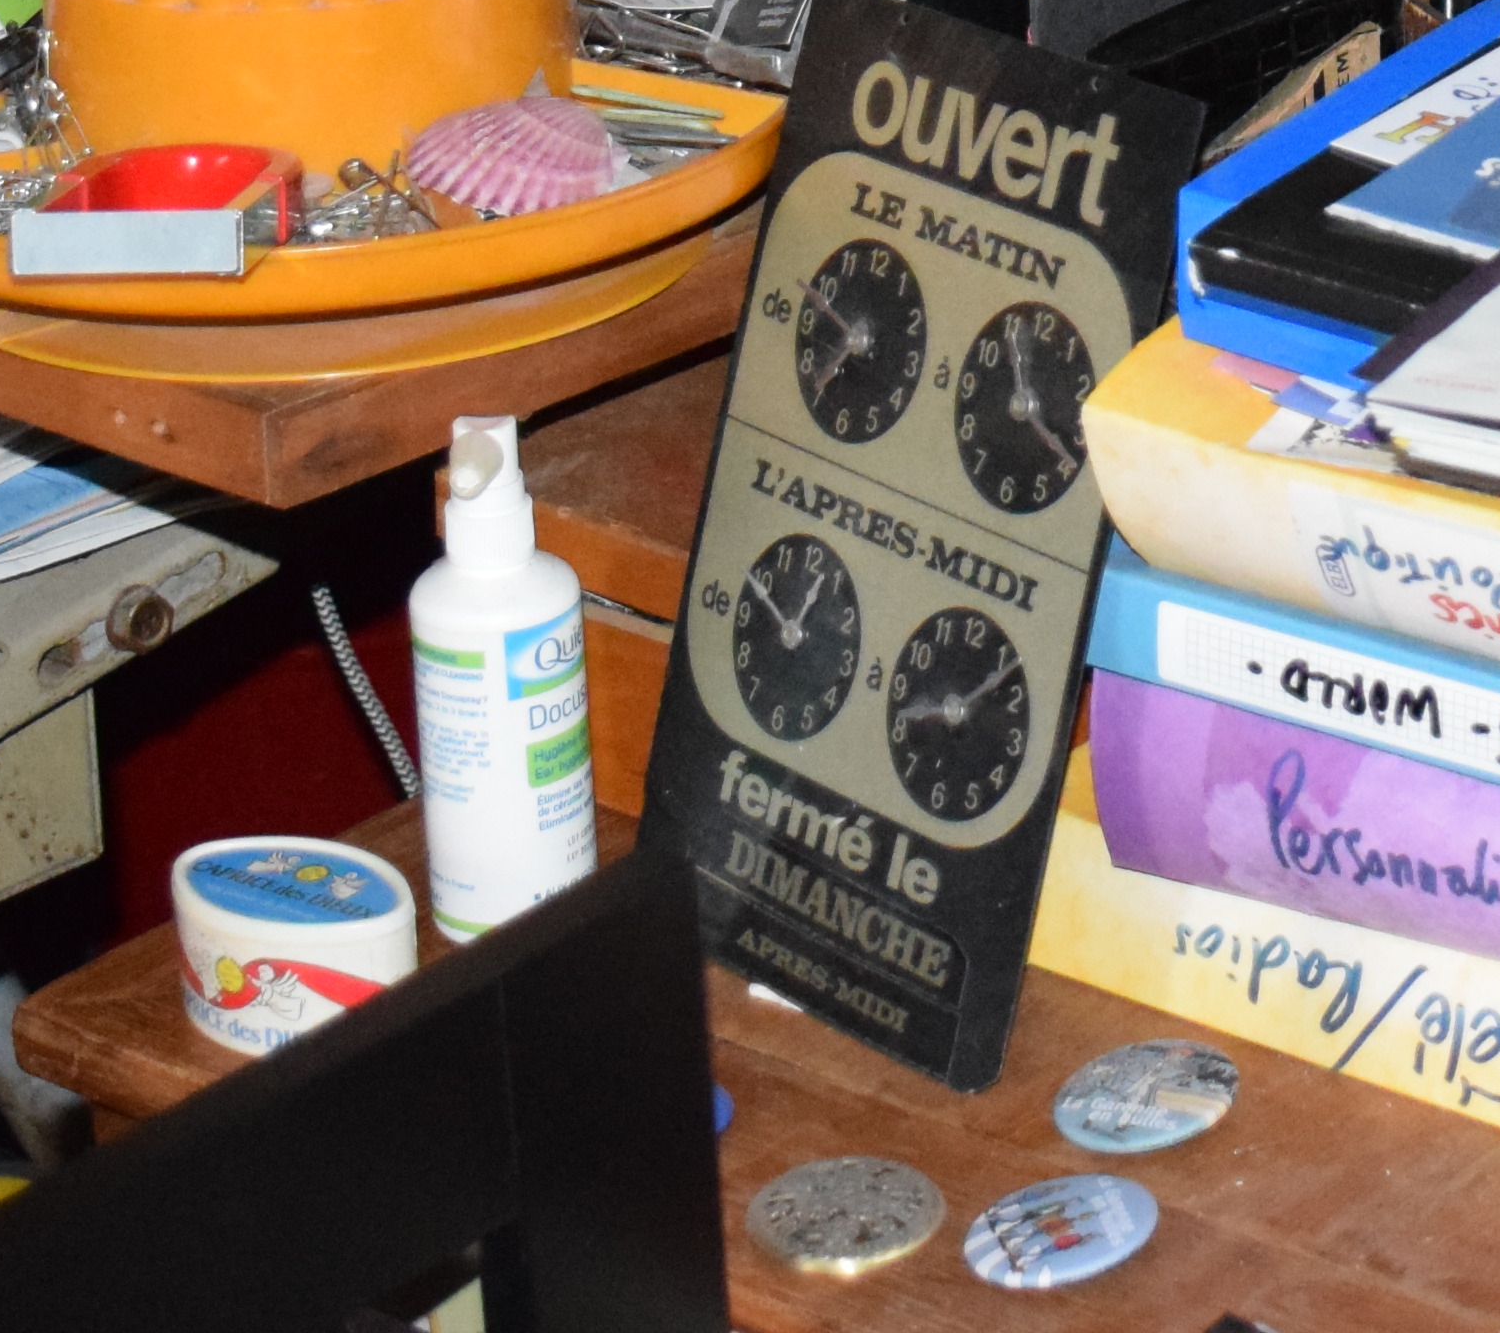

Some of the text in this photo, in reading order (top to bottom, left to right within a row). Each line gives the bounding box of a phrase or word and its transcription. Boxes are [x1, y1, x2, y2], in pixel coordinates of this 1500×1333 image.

[851, 183, 1067, 290] LE MATIN
[762, 287, 951, 390] de à
[750, 459, 1039, 615] L'APRES-MIDI
[701, 578, 885, 692] de à
[528, 683, 587, 731] Docus
[192, 861, 276, 891] CAPRICE
[274, 884, 304, 900] des
[718, 746, 941, 908] fermé le
[724, 832, 951, 990] DIMANCHE
[228, 1017, 262, 1046] des
[736, 926, 906, 1033] APRES-MIDI
